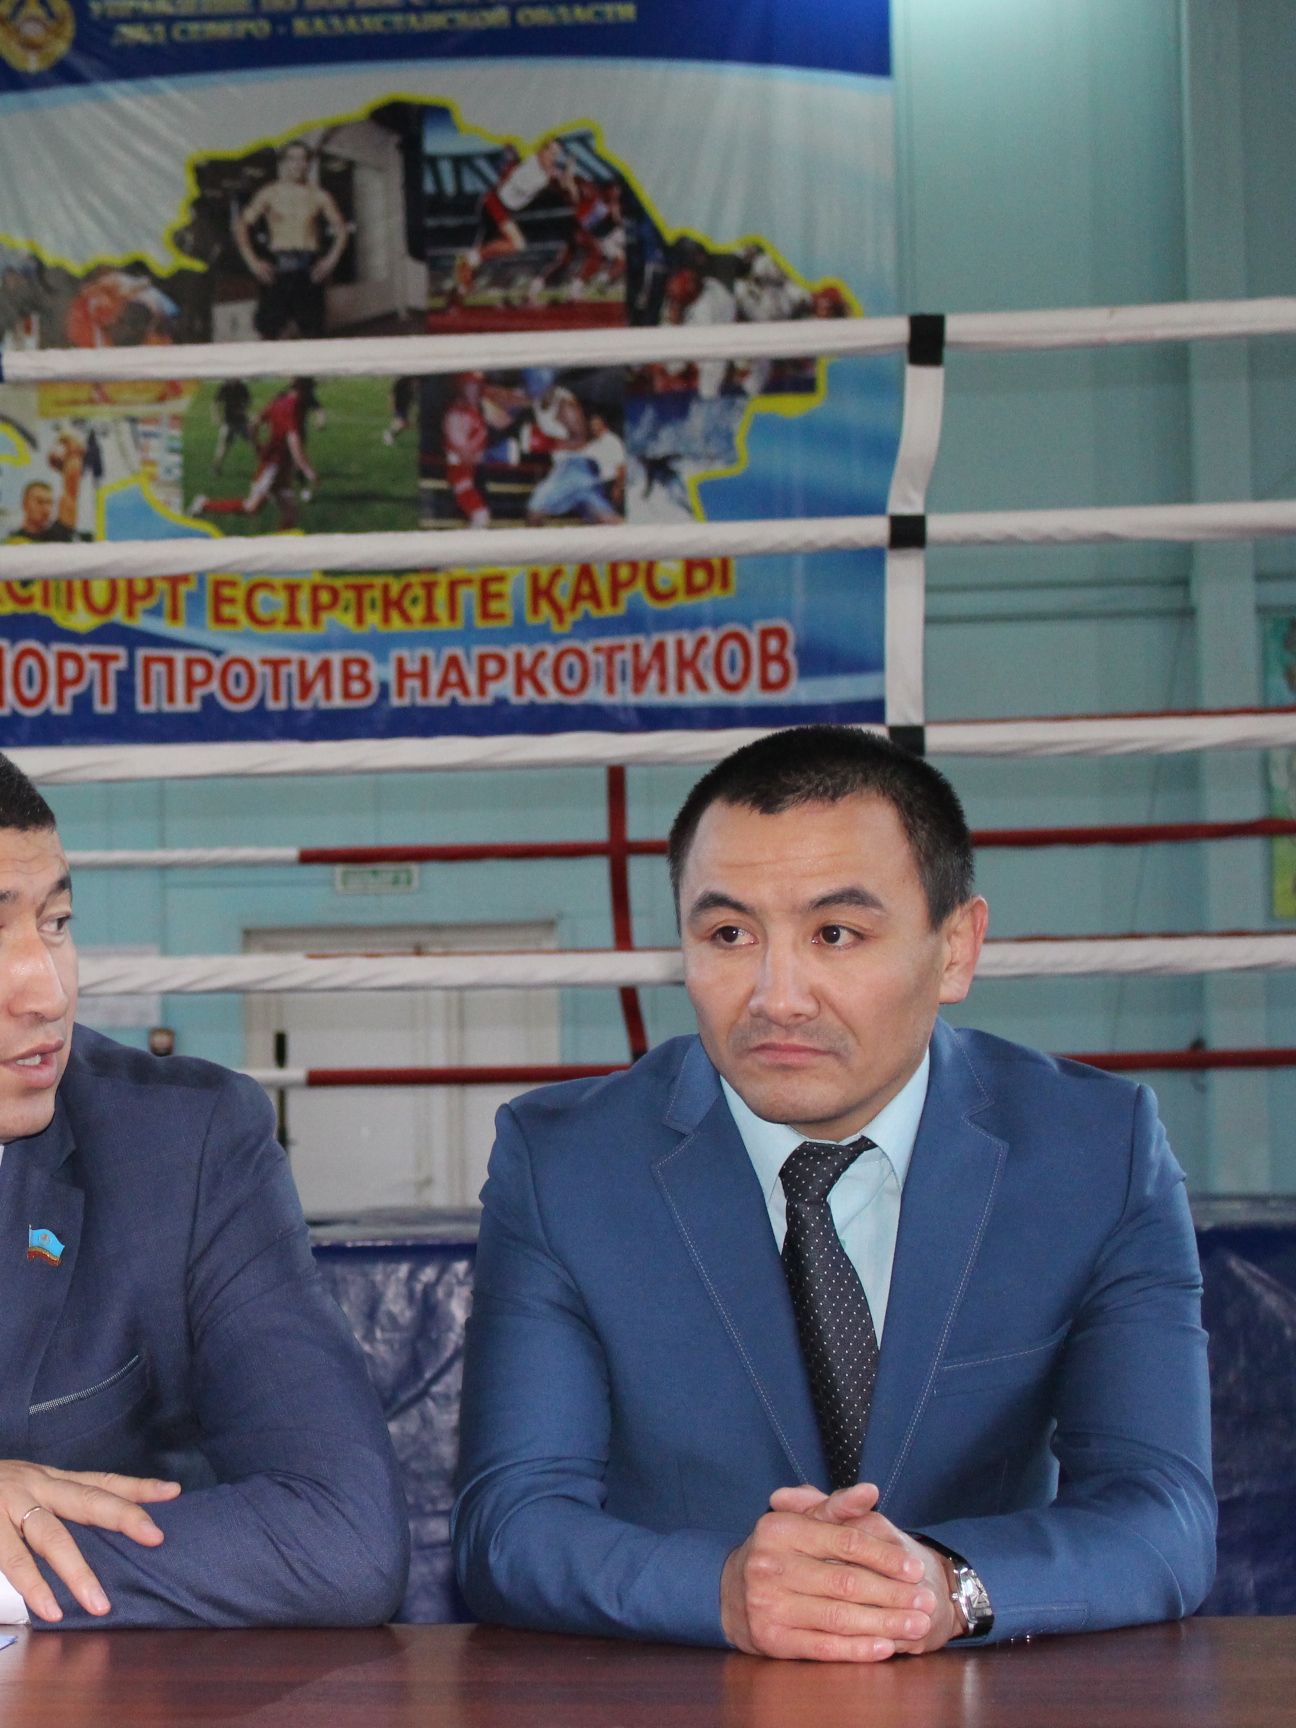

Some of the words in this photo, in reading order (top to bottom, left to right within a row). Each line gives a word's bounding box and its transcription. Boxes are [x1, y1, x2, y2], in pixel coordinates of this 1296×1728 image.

[210, 573, 509, 628] ЕСІРТКІГЕ
[529, 557, 731, 628] ҚАРСЫ
[139, 652, 375, 705] ПРОТИВ
[392, 624, 795, 699] НАРКОТИКОВ
